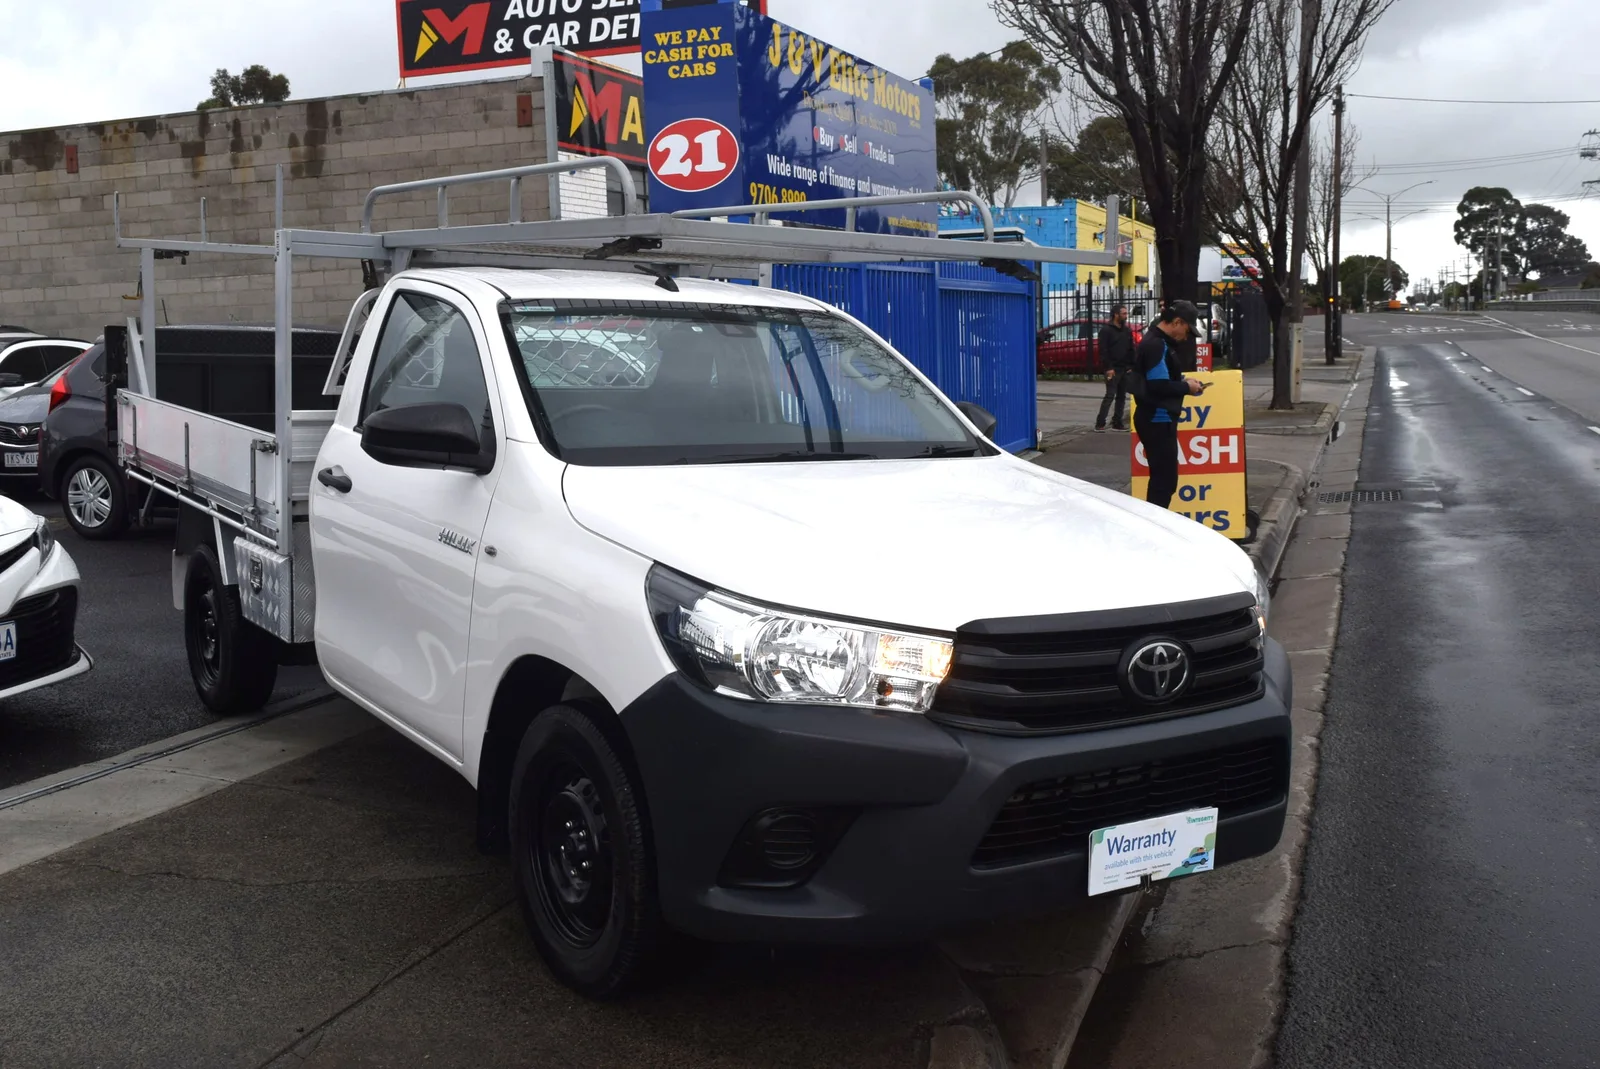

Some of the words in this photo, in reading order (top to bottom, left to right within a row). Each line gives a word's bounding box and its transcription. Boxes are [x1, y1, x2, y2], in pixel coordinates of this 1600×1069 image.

[503, 0, 582, 20] AUTO
[493, 28, 514, 53] &
[522, 20, 580, 49] CAR
[654, 31, 682, 46] WE
[686, 26, 722, 43] PAY
[644, 47, 693, 64] CASH
[697, 43, 734, 59] FOR
[668, 61, 717, 79] CARS
[768, 23, 781, 67] J
[787, 31, 805, 75] &
[810, 40, 824, 83] V
[829, 48, 869, 101] Elite
[873, 68, 921, 121] Motors
[656, 129, 726, 177] 21
[819, 126, 834, 152] Buy
[844, 134, 857, 154] Sell
[869, 142, 887, 162] Trade
[888, 149, 895, 165] in
[767, 153, 791, 177] Wide
[793, 164, 818, 187] range
[819, 166, 828, 185] of
[829, 166, 856, 190] finance
[857, 176, 871, 194] and
[750, 182, 778, 205] 9706
[1177, 405, 1212, 429] ay
[1178, 484, 1212, 503] or
[1106, 828, 1177, 856] Warranty
[1104, 858, 1129, 871] available
[1129, 855, 1142, 865] with
[1142, 853, 1153, 862] this
